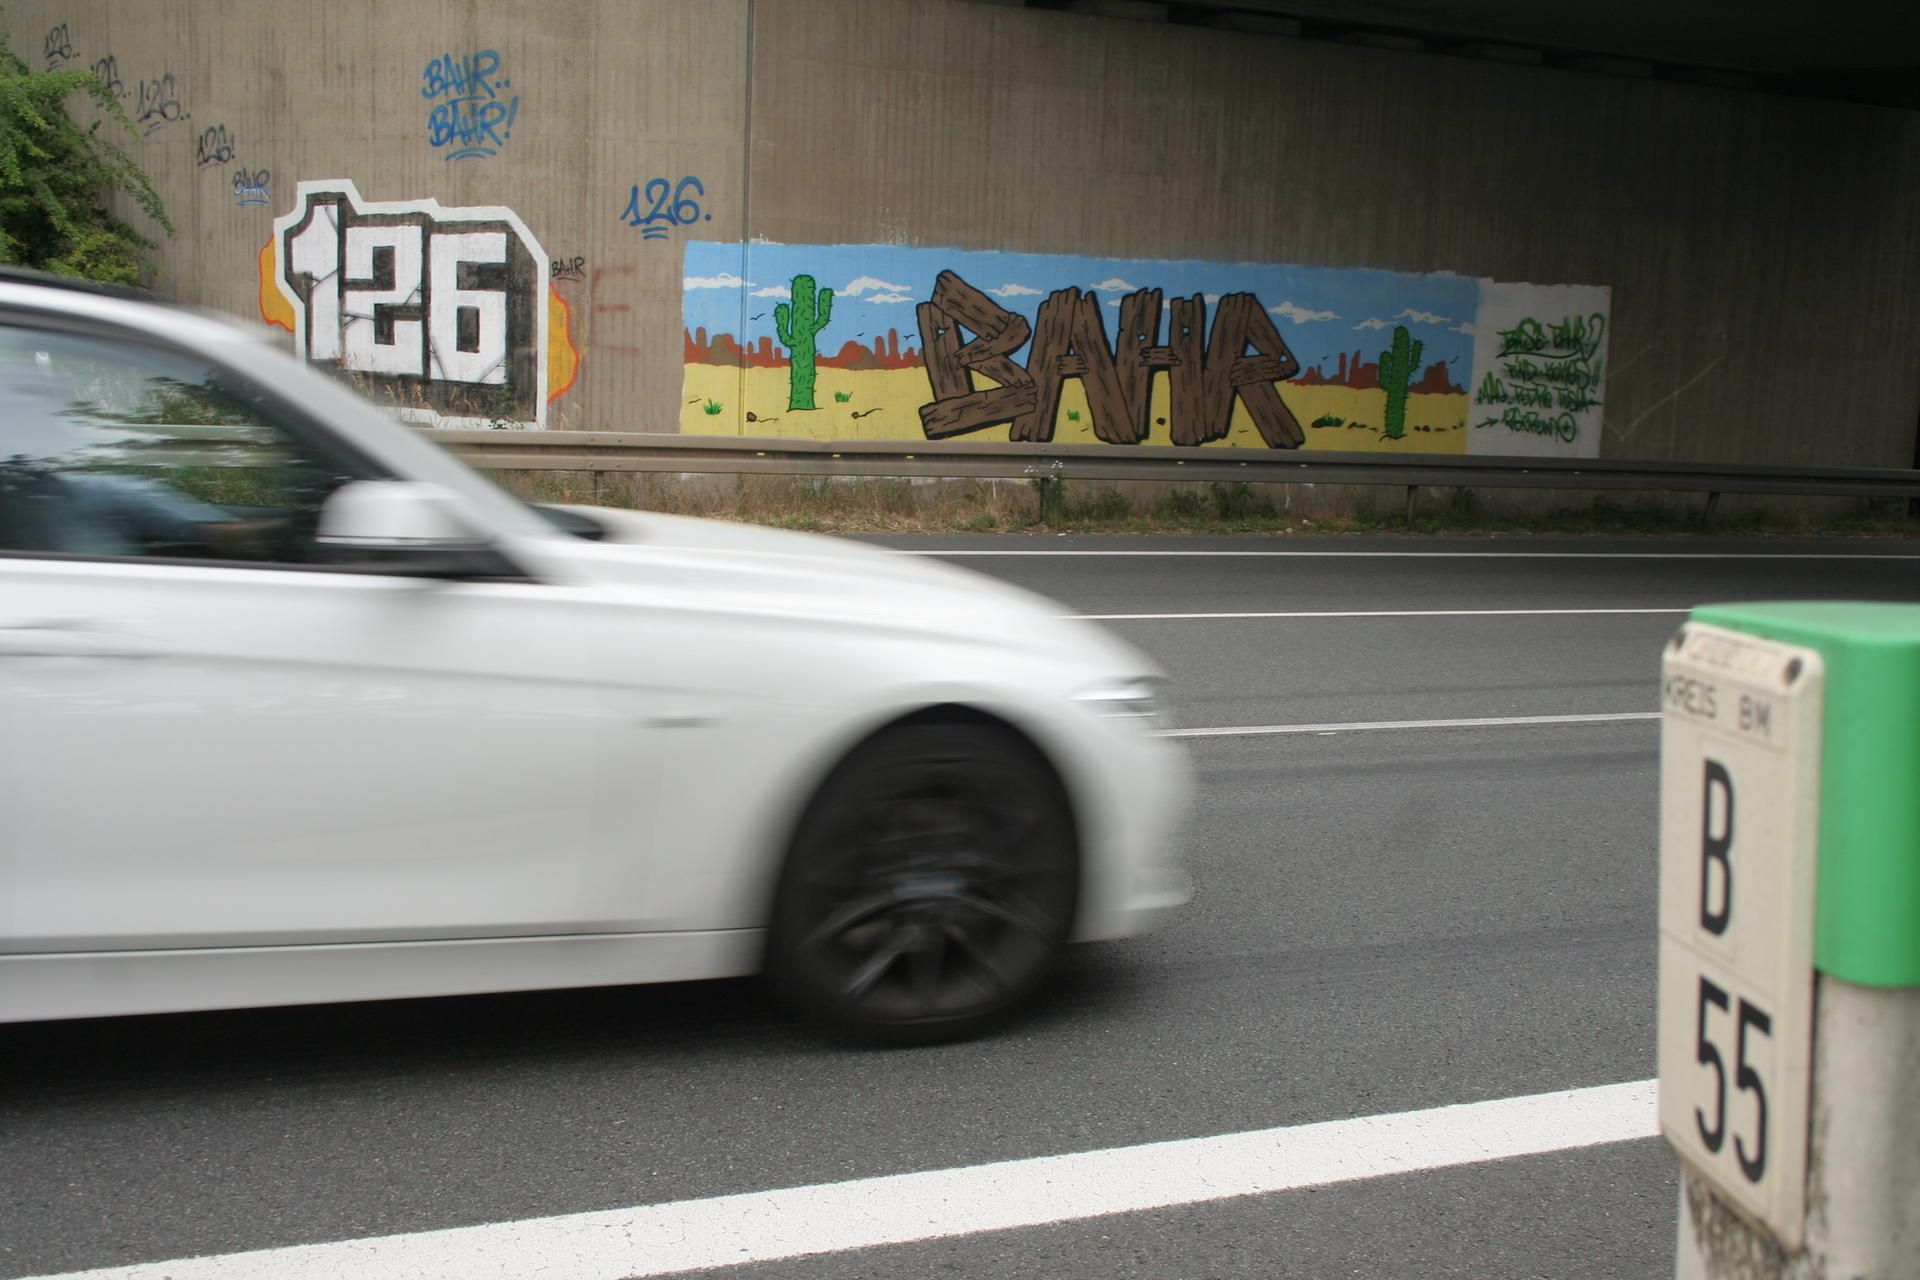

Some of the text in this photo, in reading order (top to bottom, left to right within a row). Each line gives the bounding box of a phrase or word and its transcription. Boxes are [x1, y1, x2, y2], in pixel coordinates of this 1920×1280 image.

[286, 198, 514, 389] 126
[551, 255, 587, 277] BAHR
[916, 268, 1307, 450] BAHR
[1665, 675, 1771, 738] KREIS BM
[1700, 757, 1736, 936] B
[1695, 974, 1773, 1185] 55
